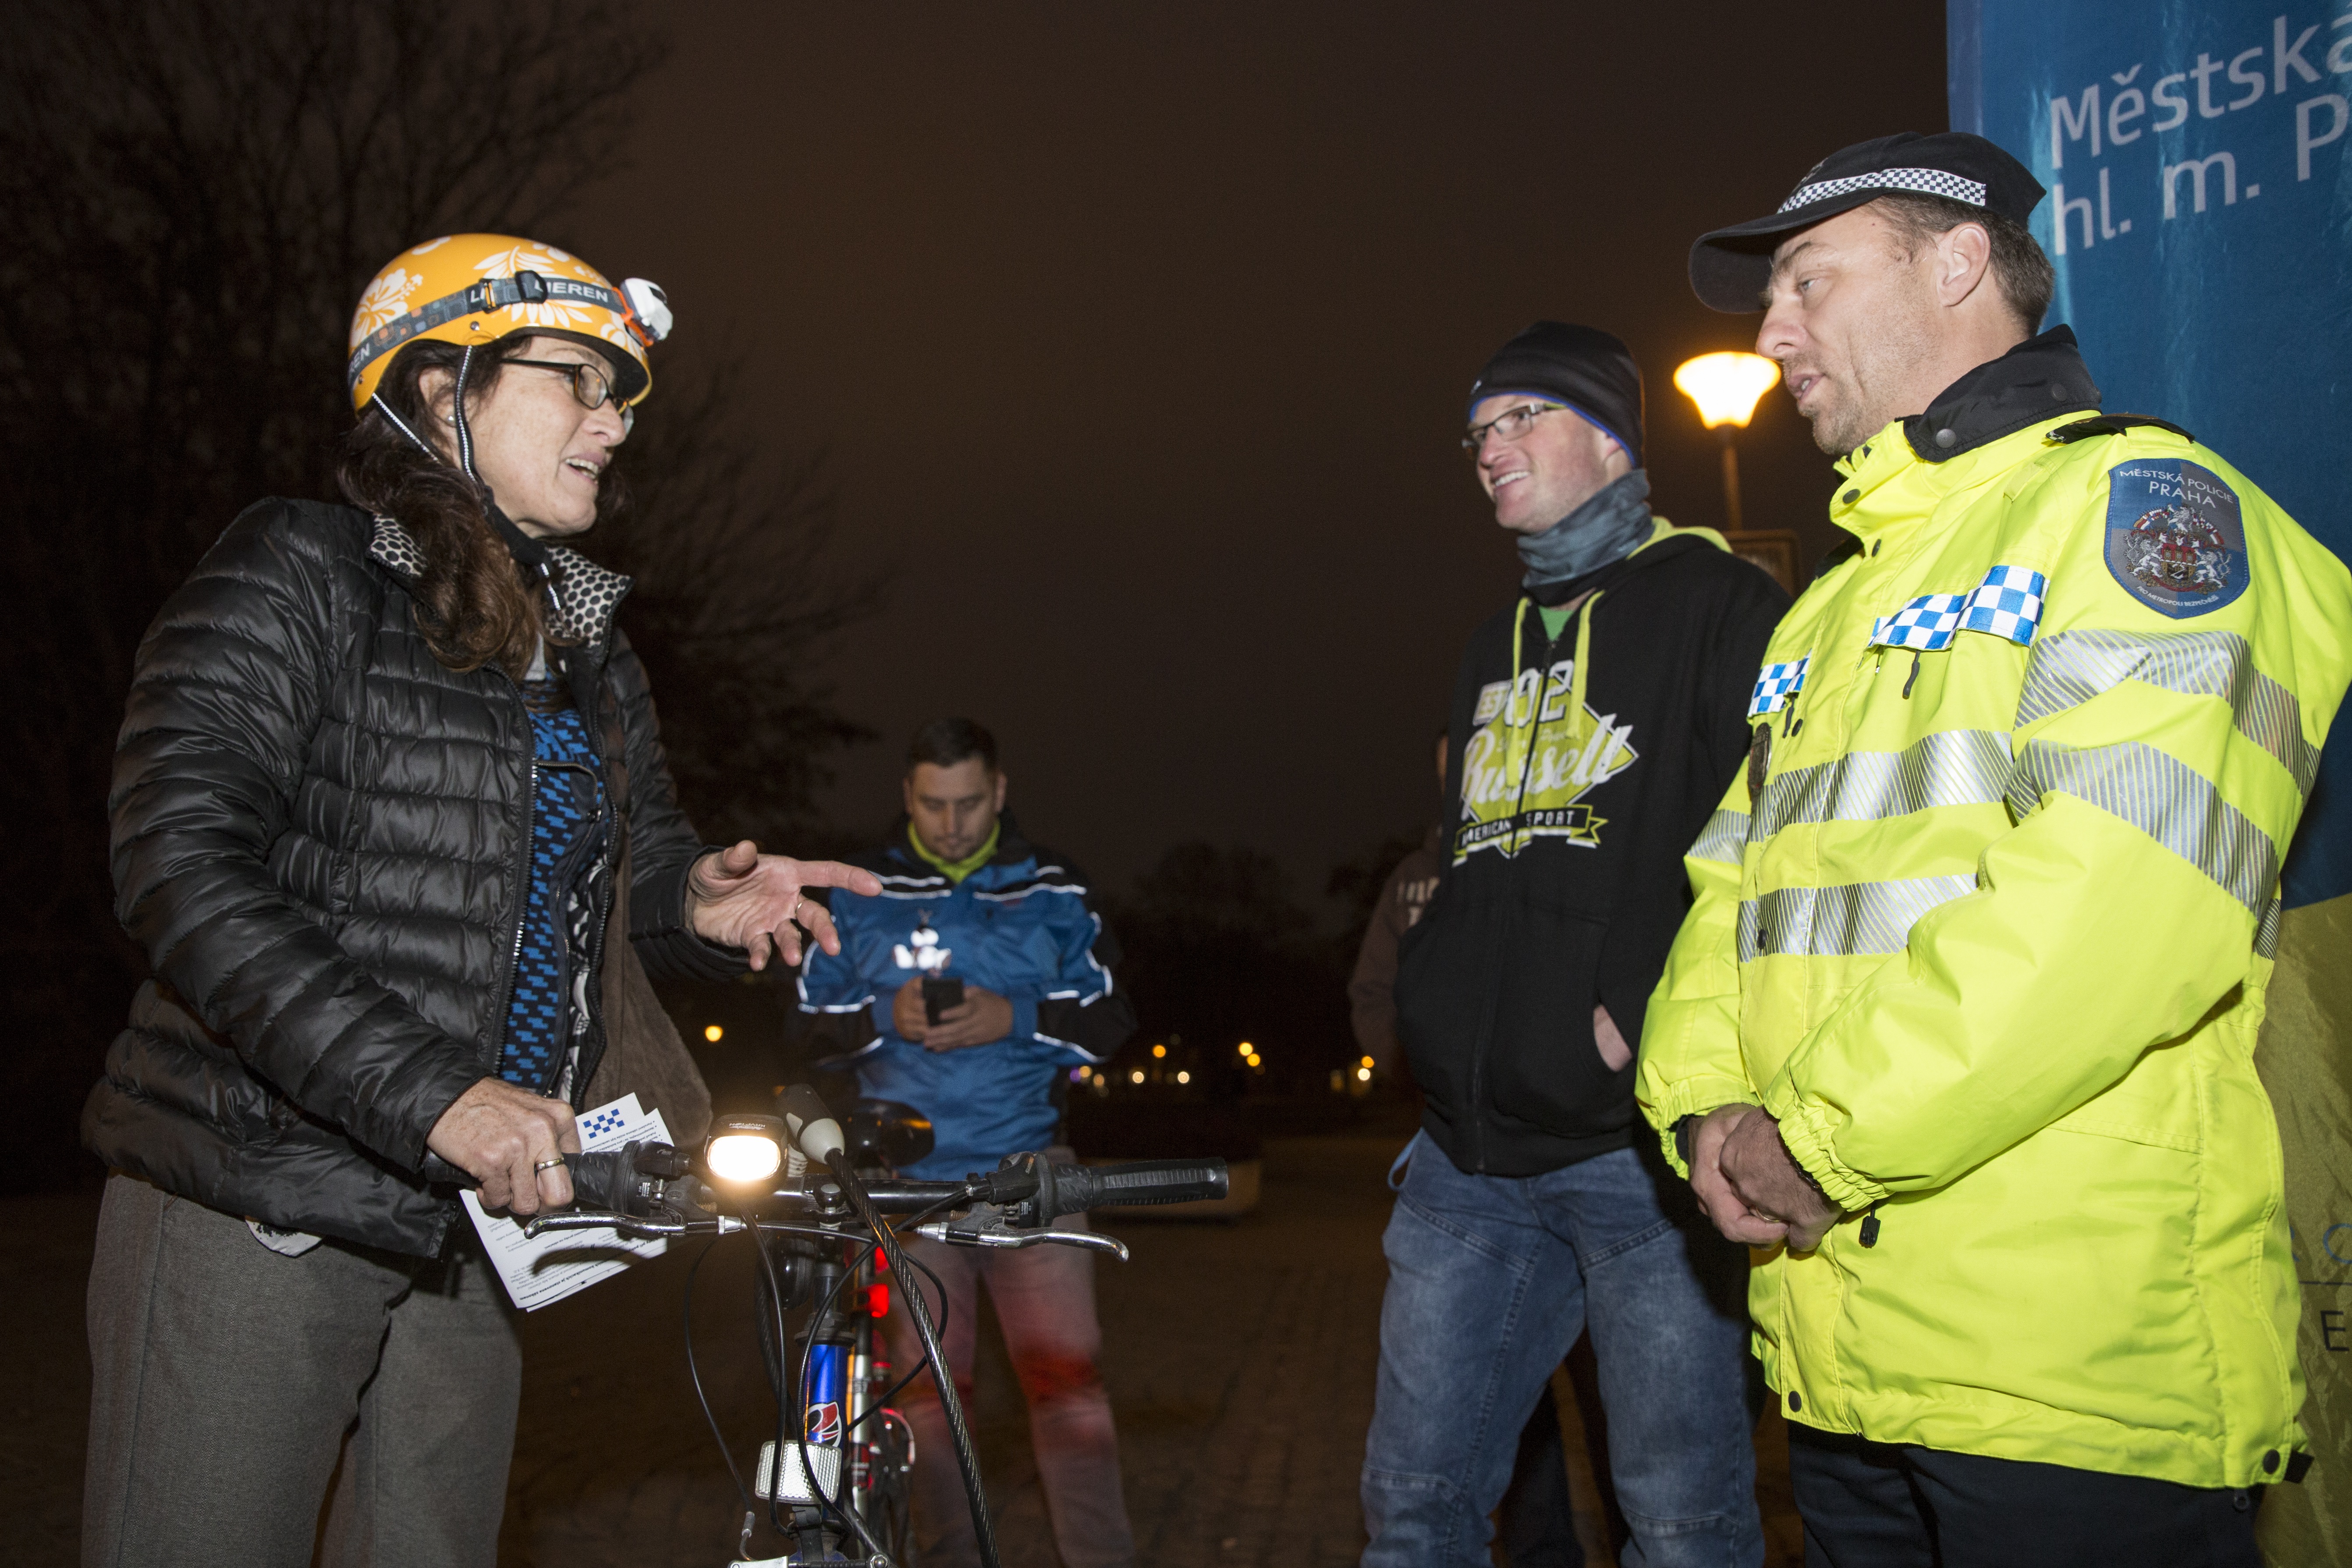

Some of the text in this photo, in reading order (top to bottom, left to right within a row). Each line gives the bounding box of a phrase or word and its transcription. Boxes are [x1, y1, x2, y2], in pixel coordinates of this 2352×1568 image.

[2053, 167, 2132, 255] hl.
[2163, 151, 2260, 220] m.
[2120, 468, 2234, 504] MĚSTSKÁ POLICIE
[2149, 481, 2216, 508] PRAHA
[2136, 585, 2148, 595] PRO
[2147, 592, 2183, 606] METROPOLI
[1525, 810, 1575, 827] SPORT
